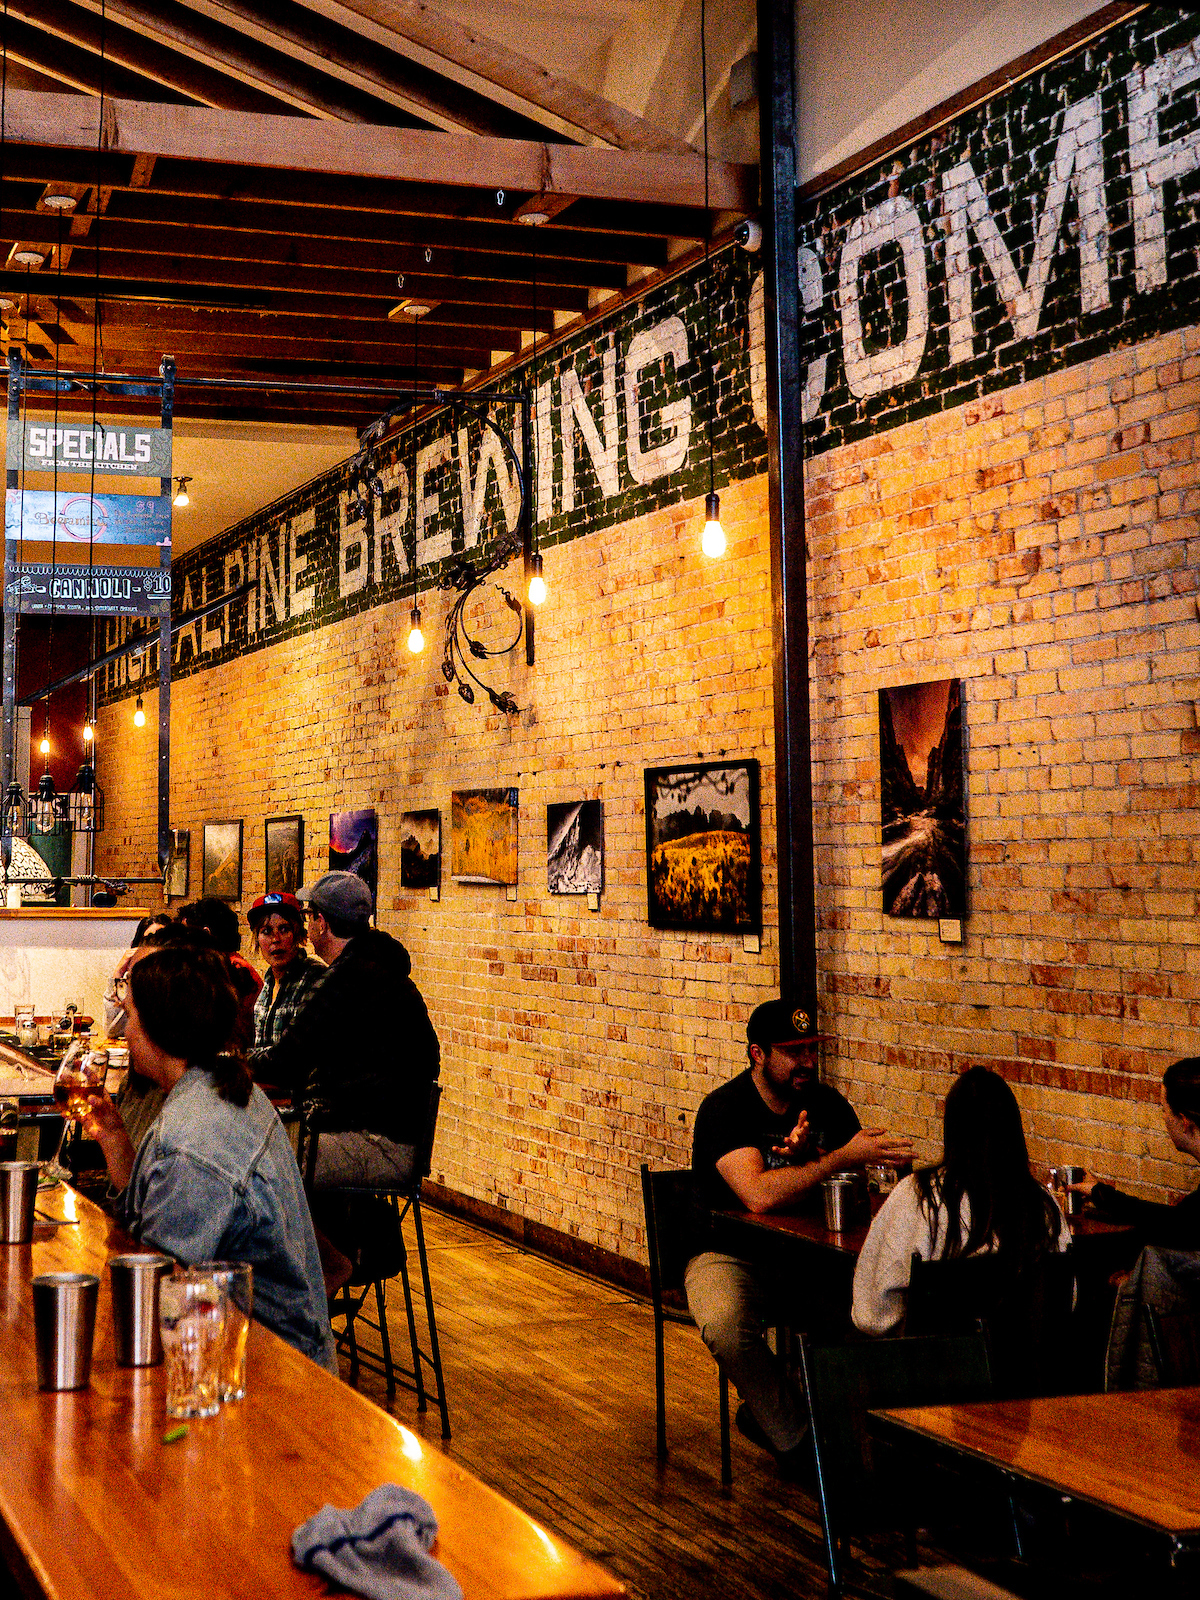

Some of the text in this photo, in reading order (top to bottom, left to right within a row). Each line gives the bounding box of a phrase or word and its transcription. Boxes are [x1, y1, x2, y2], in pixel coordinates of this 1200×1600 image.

[29, 428, 151, 462] SPECIALS
[41, 459, 69, 467] FROM
[94, 462, 138, 471] KITCHEN
[174, 511, 320, 664] ALPINE
[340, 314, 692, 599] BREWING
[143, 575, 171, 594] $10
